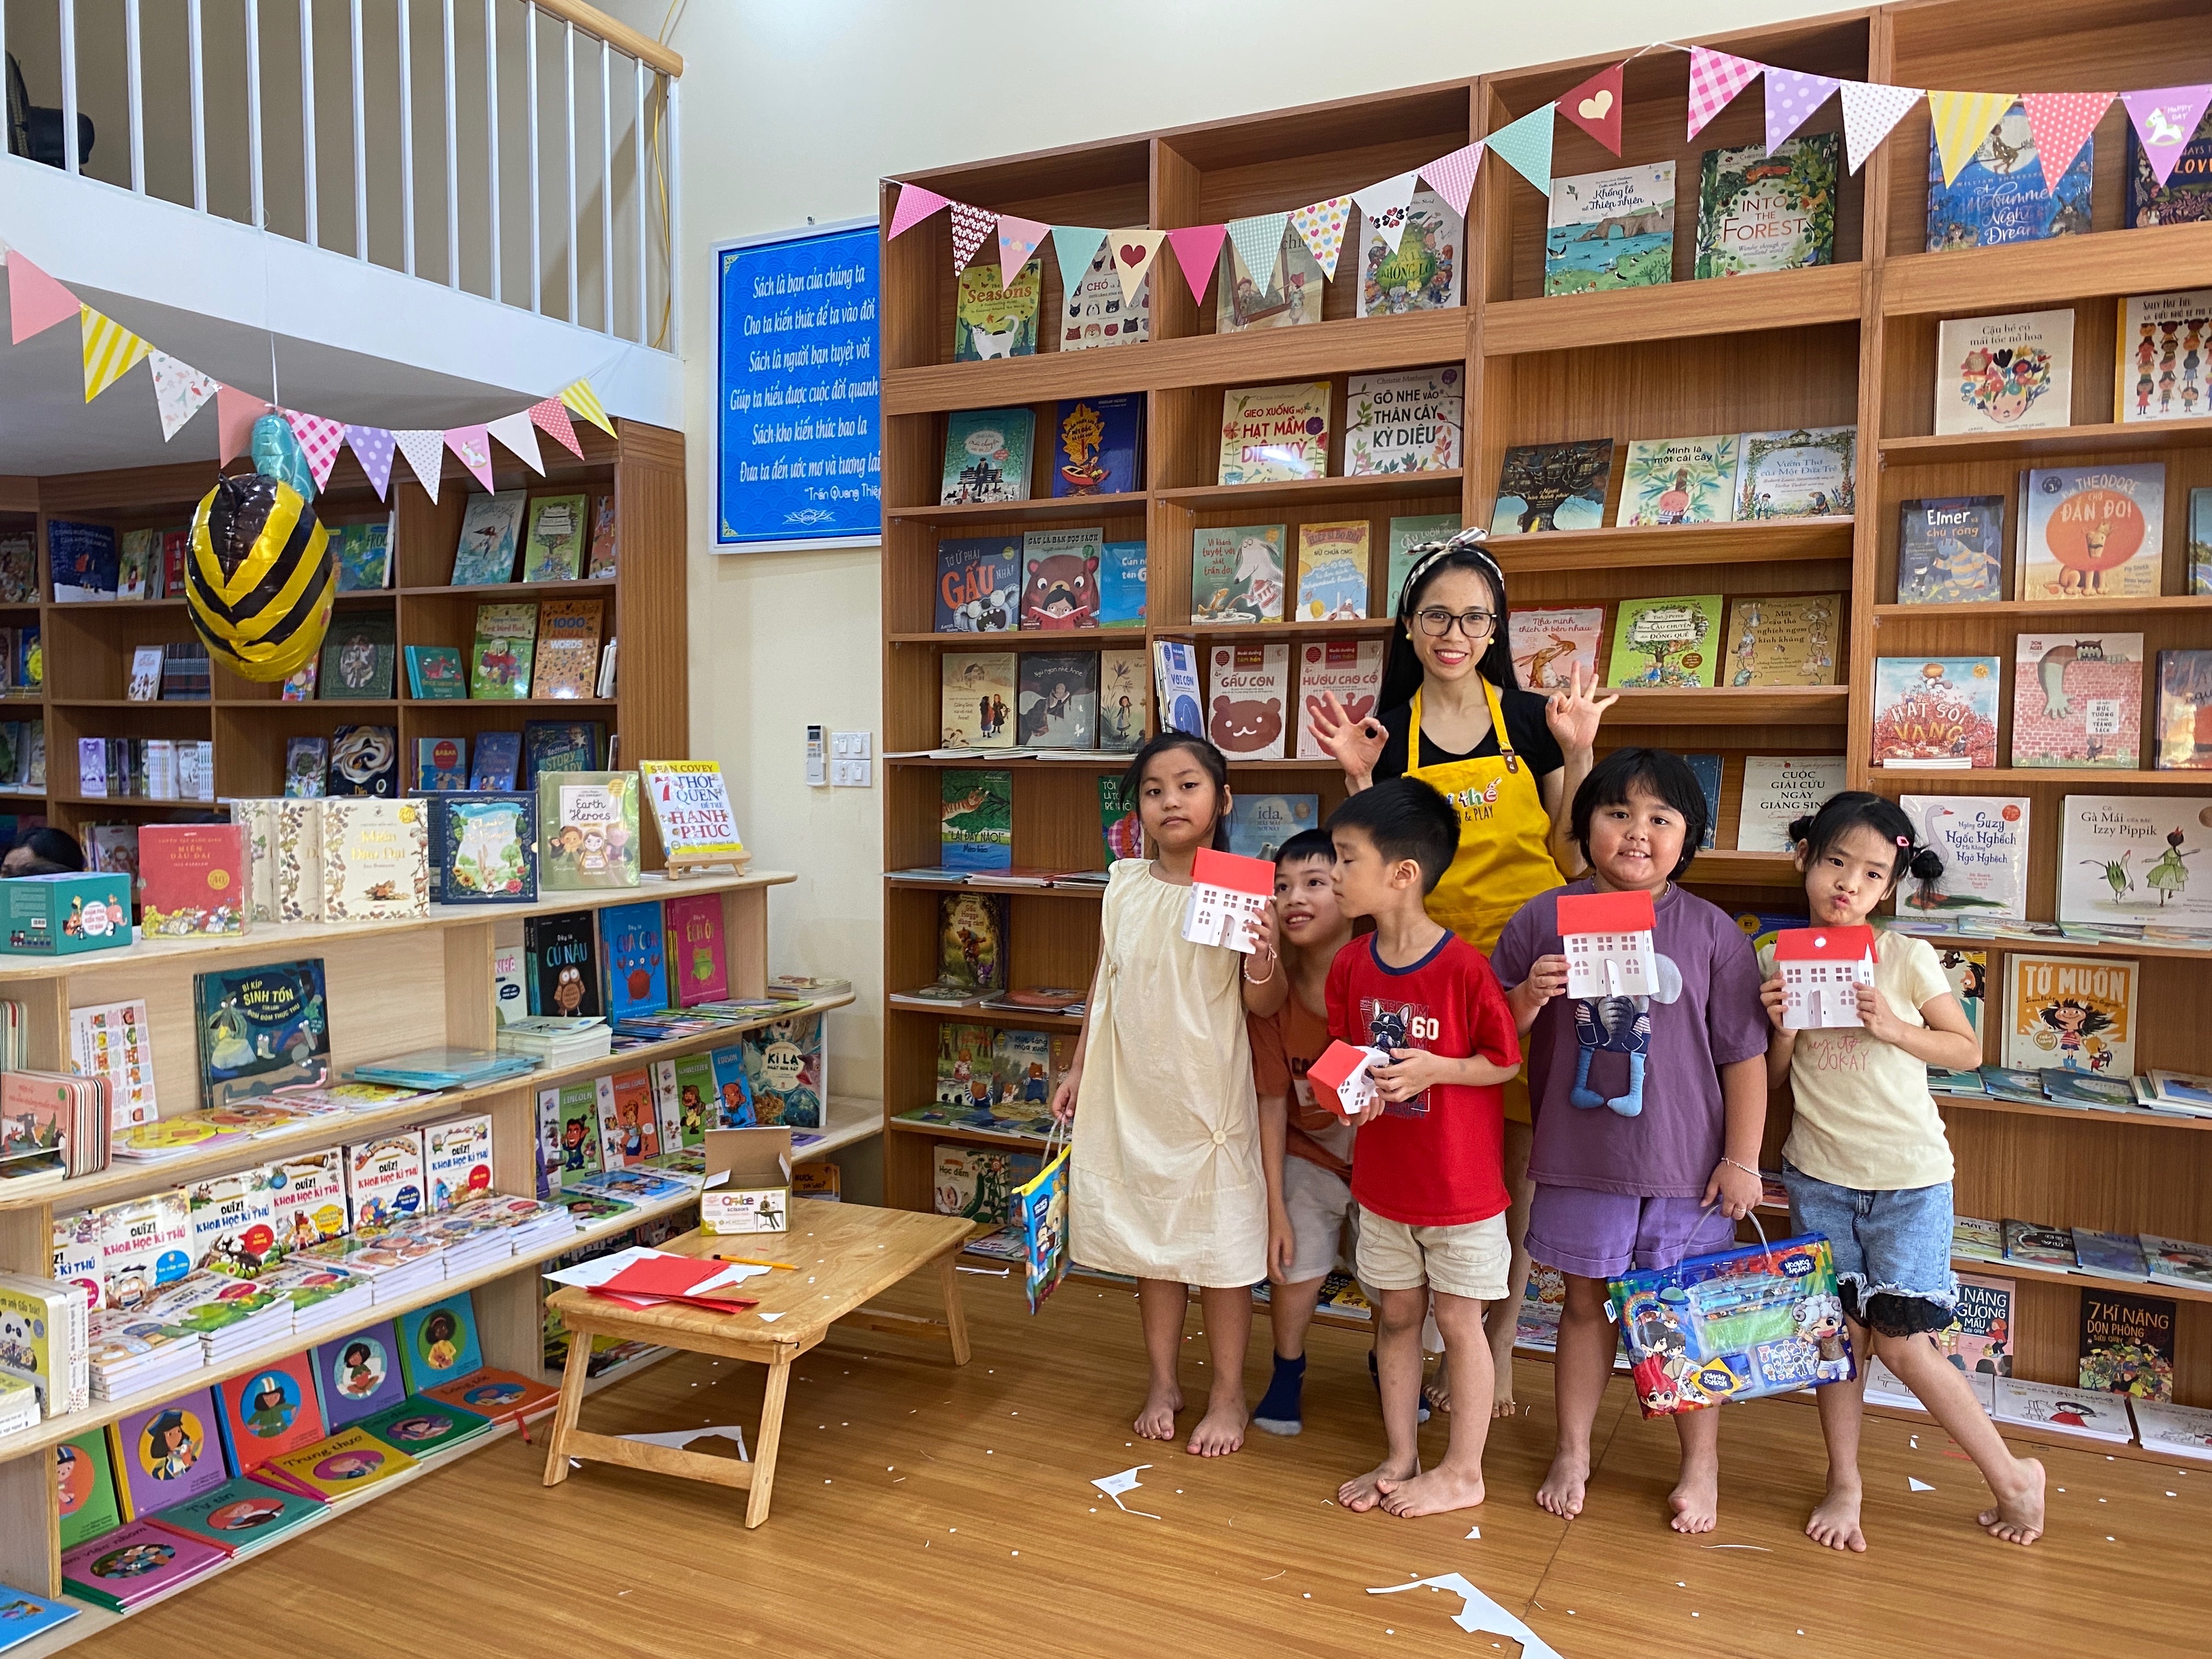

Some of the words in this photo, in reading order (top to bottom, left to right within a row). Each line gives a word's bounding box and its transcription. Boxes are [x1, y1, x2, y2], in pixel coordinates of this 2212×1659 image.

[1742, 195, 1787, 212] INTO
[1756, 211, 1776, 220] THE
[1724, 218, 1806, 243] FOREST
[753, 276, 774, 298] Sách
[776, 274, 785, 295] là
[787, 273, 804, 297] bạn
[806, 267, 822, 290] của
[825, 264, 853, 289] chúng
[855, 264, 865, 283] ta
[1087, 279, 1108, 291] CHÓ
[968, 286, 1031, 303] Seasons
[744, 315, 760, 336] Cho
[763, 315, 772, 334] ta
[774, 307, 793, 332] kiến
[795, 307, 814, 329] thức
[816, 299, 830, 326] để
[830, 305, 839, 325] ta
[842, 301, 857, 323] vào
[860, 297, 875, 320] đời
[749, 351, 770, 372] Sách
[772, 348, 781, 369] là
[783, 344, 809, 373] người
[811, 345, 828, 369] bạn
[831, 339, 853, 367] tuyệt
[856, 336, 871, 359] vời
[1402, 374, 1434, 382] Matheson
[730, 389, 751, 414] Giúp
[753, 391, 762, 408] ta
[764, 380, 783, 407] hiểu
[785, 385, 806, 409] được
[809, 380, 830, 406] cuộc
[832, 377, 847, 400] đời
[848, 376, 879, 403] quanh
[1244, 408, 1263, 417] GIEO
[1266, 403, 1294, 416] XUỐNG
[1374, 408, 1410, 424] THÂN
[1414, 404, 1438, 421] CÂY
[794, 416, 813, 441] kiến
[816, 417, 836, 439] thức
[838, 417, 855, 437] bao
[857, 415, 867, 436] la
[1242, 423, 1270, 439] HẠT
[1274, 416, 1305, 436] MẦM
[1373, 427, 1393, 448] KỲ
[1397, 424, 1436, 449] DIỆU
[740, 461, 758, 482] Đưa
[760, 463, 770, 480] ta
[772, 455, 788, 479] đến
[791, 458, 806, 479] ước
[808, 459, 824, 477] mơ
[825, 454, 836, 476] và
[839, 456, 866, 478] tương
[868, 450, 881, 472] lai
[1654, 456, 1672, 464] một
[2075, 474, 2139, 494] THEODORE
[1927, 509, 1971, 526] Elmer
[1927, 524, 1946, 536] chú
[1952, 524, 1979, 537] rồng
[1122, 557, 1137, 566] Cún
[942, 561, 995, 610] GẤU
[553, 617, 585, 628] 1000
[551, 640, 583, 648] WORDS
[1171, 674, 1182, 684] VOI
[1183, 676, 1194, 686] CON
[1221, 673, 1246, 687] GẤU
[1249, 676, 1274, 686] CON
[1303, 674, 1335, 685] HƯƠU
[1339, 674, 1360, 684] CAO
[1363, 669, 1378, 683] CỔ
[548, 744, 570, 755] Bedtime
[545, 751, 575, 769] STORY
[1782, 770, 1815, 780] CUỘC
[655, 776, 670, 802] 7
[1103, 781, 1116, 789] TÔI
[1771, 780, 1796, 788] GIẢI
[1799, 780, 1825, 788] CỨU
[1781, 790, 1814, 798] NGÀY
[577, 799, 606, 808] Earth
[1760, 800, 1799, 809] GIÁNG
[570, 809, 610, 821] Heroes
[1465, 811, 1471, 821] &
[1474, 805, 1493, 821] PLAY
[2081, 812, 2097, 821] Gà
[2102, 812, 2123, 822] Mái
[1976, 812, 2005, 832] Suzy
[680, 823, 731, 839] PHÚC
[1946, 831, 1973, 848] Ngốc
[1977, 831, 2016, 848] Nghếch
[2094, 824, 2115, 837] Izzy
[2120, 825, 2157, 838] Pippik
[617, 933, 635, 952] CUA
[640, 931, 658, 950] CON
[547, 943, 561, 967] CÚ
[565, 939, 587, 963] NÂU
[242, 981, 249, 992] BÍ
[251, 979, 262, 989] KÍP
[2025, 963, 2052, 996] TỚ
[2059, 967, 2124, 1003] MUỐN
[244, 990, 269, 1006] SINH
[273, 986, 294, 1003] TỒN
[1412, 1017, 1439, 1040] 60
[718, 1054, 737, 1064] EDISON
[769, 1053, 780, 1064] KÌ
[783, 1052, 798, 1065] LẠ
[678, 1064, 708, 1075] SCHWEITZER
[563, 1092, 592, 1104] LINCOLN
[432, 1160, 452, 1171] KHOA
[453, 1157, 466, 1166] HỌC
[469, 1153, 475, 1161] KÌ
[476, 1148, 488, 1160] THÚ
[358, 1178, 379, 1188] KHOA
[381, 1175, 394, 1184] HỌC
[397, 1170, 404, 1180] KÌ
[405, 1166, 417, 1176] THÚ
[274, 1195, 296, 1206] KHOA
[297, 1192, 312, 1202] HỌC
[314, 1186, 323, 1197] KÌ
[325, 1183, 340, 1194] THÚ
[196, 1221, 220, 1232] KHOA
[223, 1217, 239, 1227] HỌC
[241, 1210, 251, 1221] KÌ
[252, 1204, 269, 1218] THÚ
[104, 1241, 130, 1256] KHOA
[132, 1238, 151, 1250] HỌC
[154, 1231, 165, 1244] KÌ
[167, 1226, 185, 1241] THÚ
[61, 1265, 71, 1275] KÌ
[75, 1257, 95, 1274] THÚ
[1964, 1288, 2007, 1306] NĂNG
[2088, 1301, 2100, 1319] 7
[2103, 1304, 2119, 1320] KĨ
[2123, 1306, 2169, 1329] NĂNG
[2087, 1321, 2108, 1335] DỌN
[2112, 1322, 2144, 1338] PHÒNG
[284, 1446, 332, 1467] Trung
[333, 1434, 363, 1451] thực
